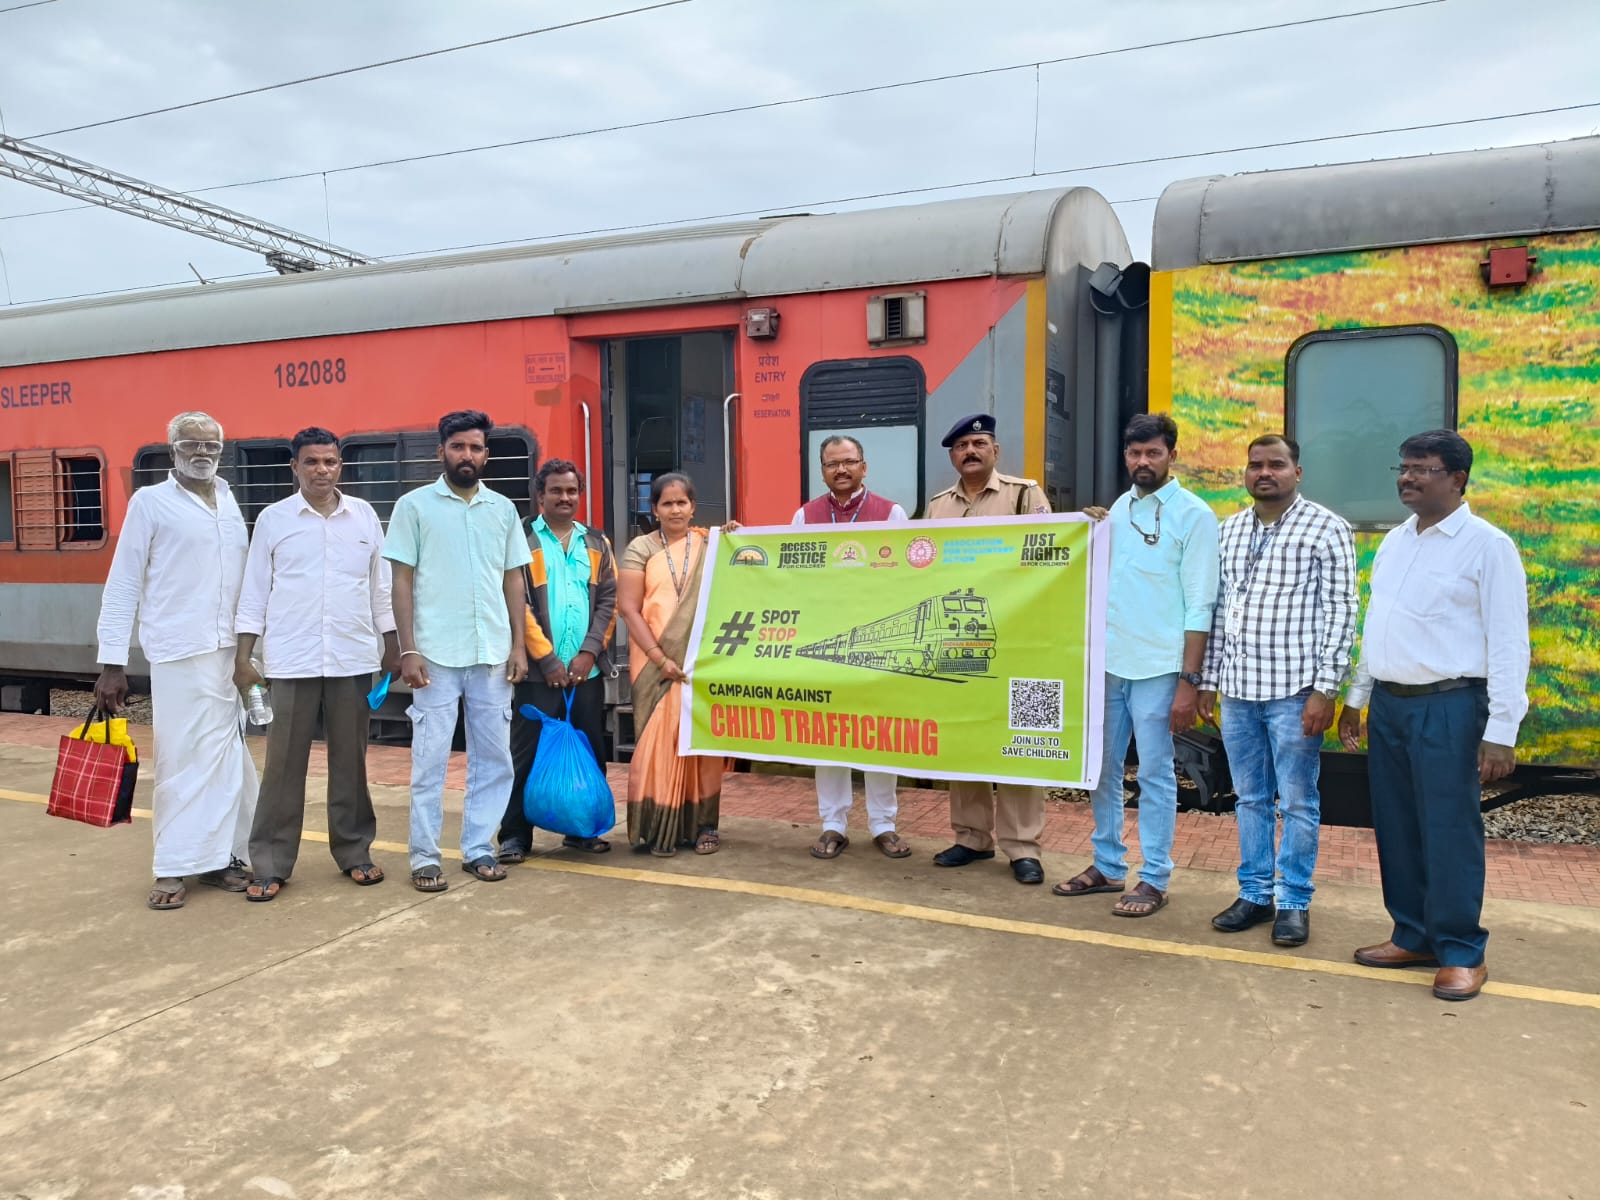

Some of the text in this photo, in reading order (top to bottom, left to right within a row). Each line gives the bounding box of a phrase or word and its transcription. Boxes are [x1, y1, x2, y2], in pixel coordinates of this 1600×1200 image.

[274, 358, 346, 389] 182088
[755, 371, 786, 383] ENTRY
[1, 381, 73, 409] SLEEPER
[818, 542, 827, 551] TO
[1023, 533, 1056, 547] JUST
[777, 552, 826, 568] JUSTICE
[1021, 547, 1070, 561] RIGHTS
[761, 609, 800, 624] SPOT
[758, 627, 797, 642] STOP
[754, 644, 792, 658] SAVE
[709, 683, 832, 703] CAMPAIGN AGAINST
[710, 703, 939, 757] CHILD TRAFFICKING
[1012, 735, 1059, 746] JOIN US TO
[1002, 746, 1069, 759] SAVE CHILDREN
